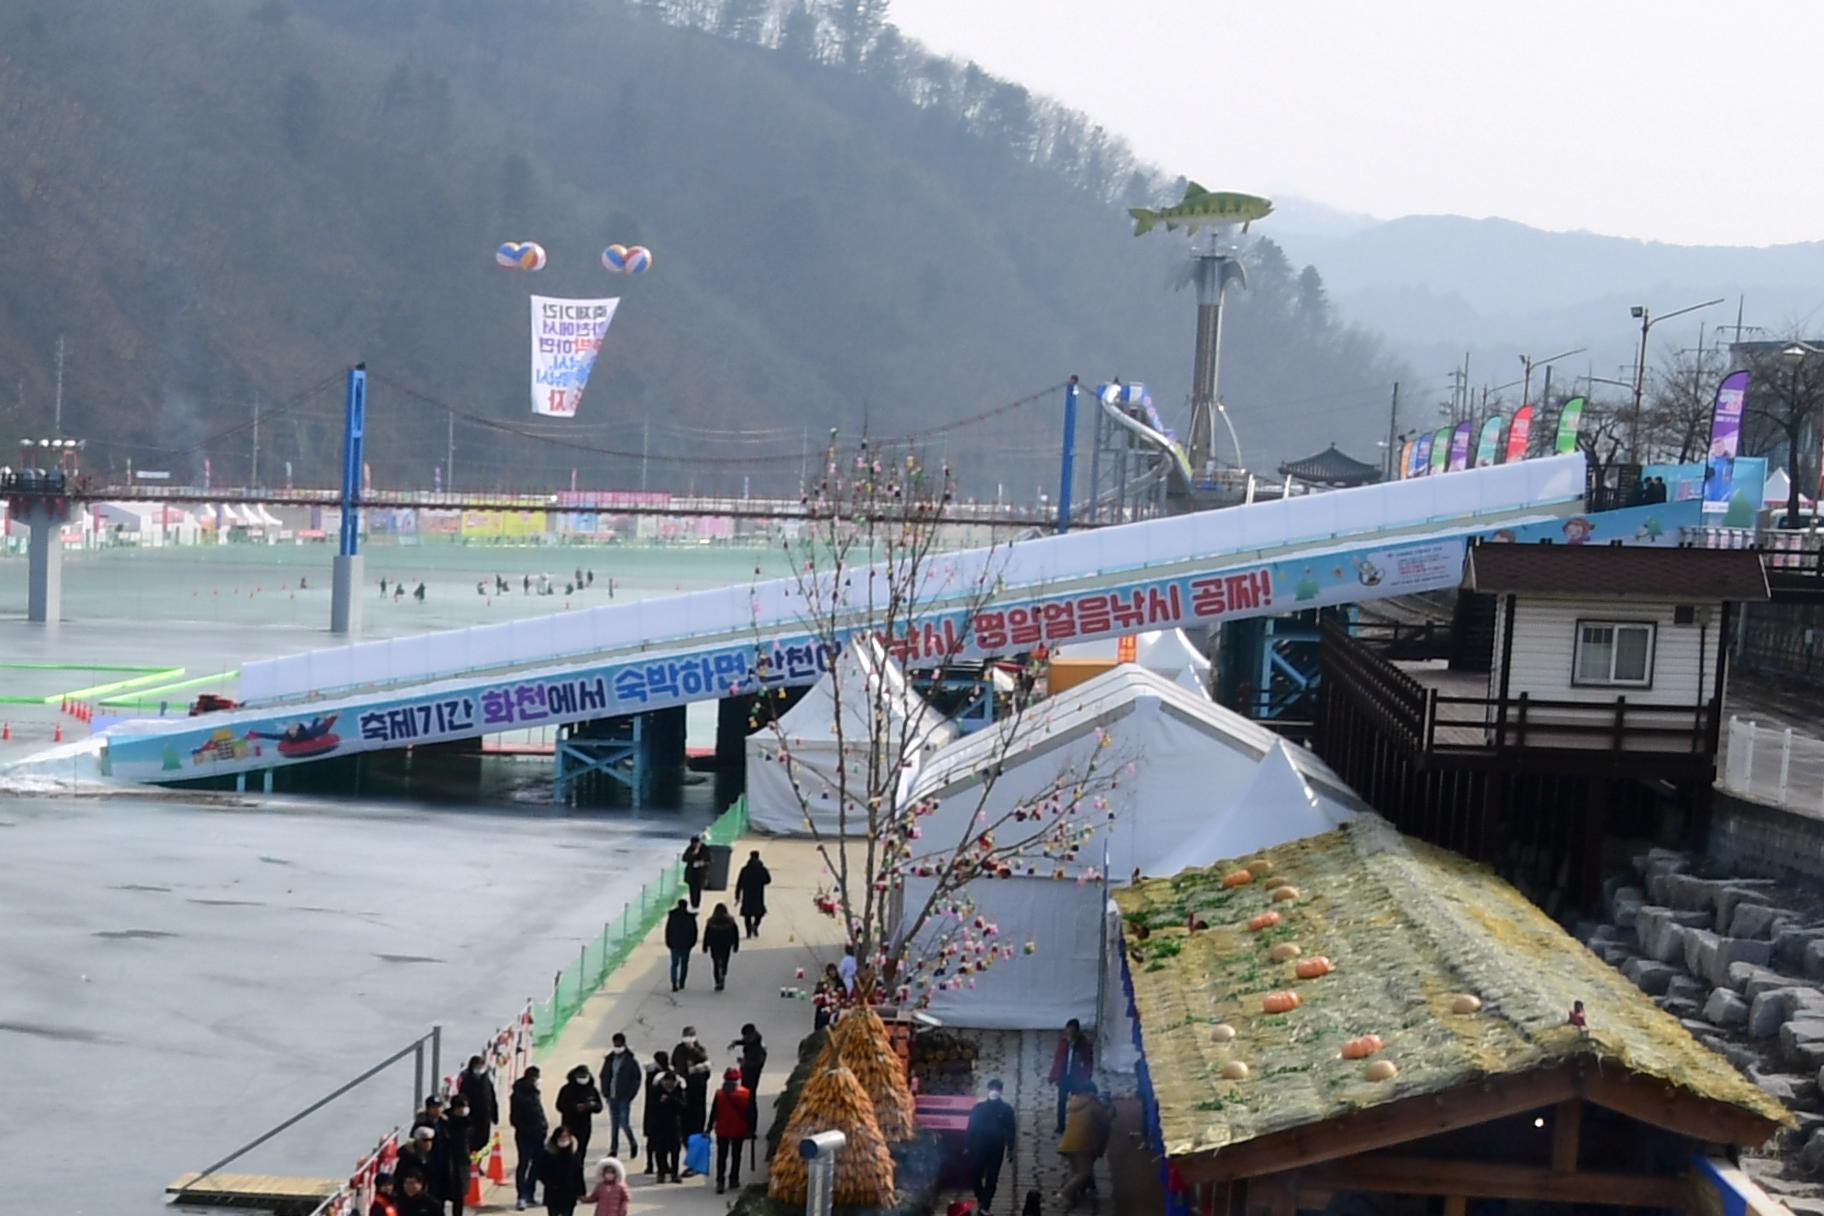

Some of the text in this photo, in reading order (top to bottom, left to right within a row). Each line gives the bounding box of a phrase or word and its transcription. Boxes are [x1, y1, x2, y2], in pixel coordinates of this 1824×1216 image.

[360, 698, 473, 741] 축제기간
[481, 679, 606, 724] 화천에서
[614, 651, 749, 702] 숙박하면
[974, 585, 1180, 650] 평일얼음낚시
[1192, 570, 1271, 616] 공짜!
